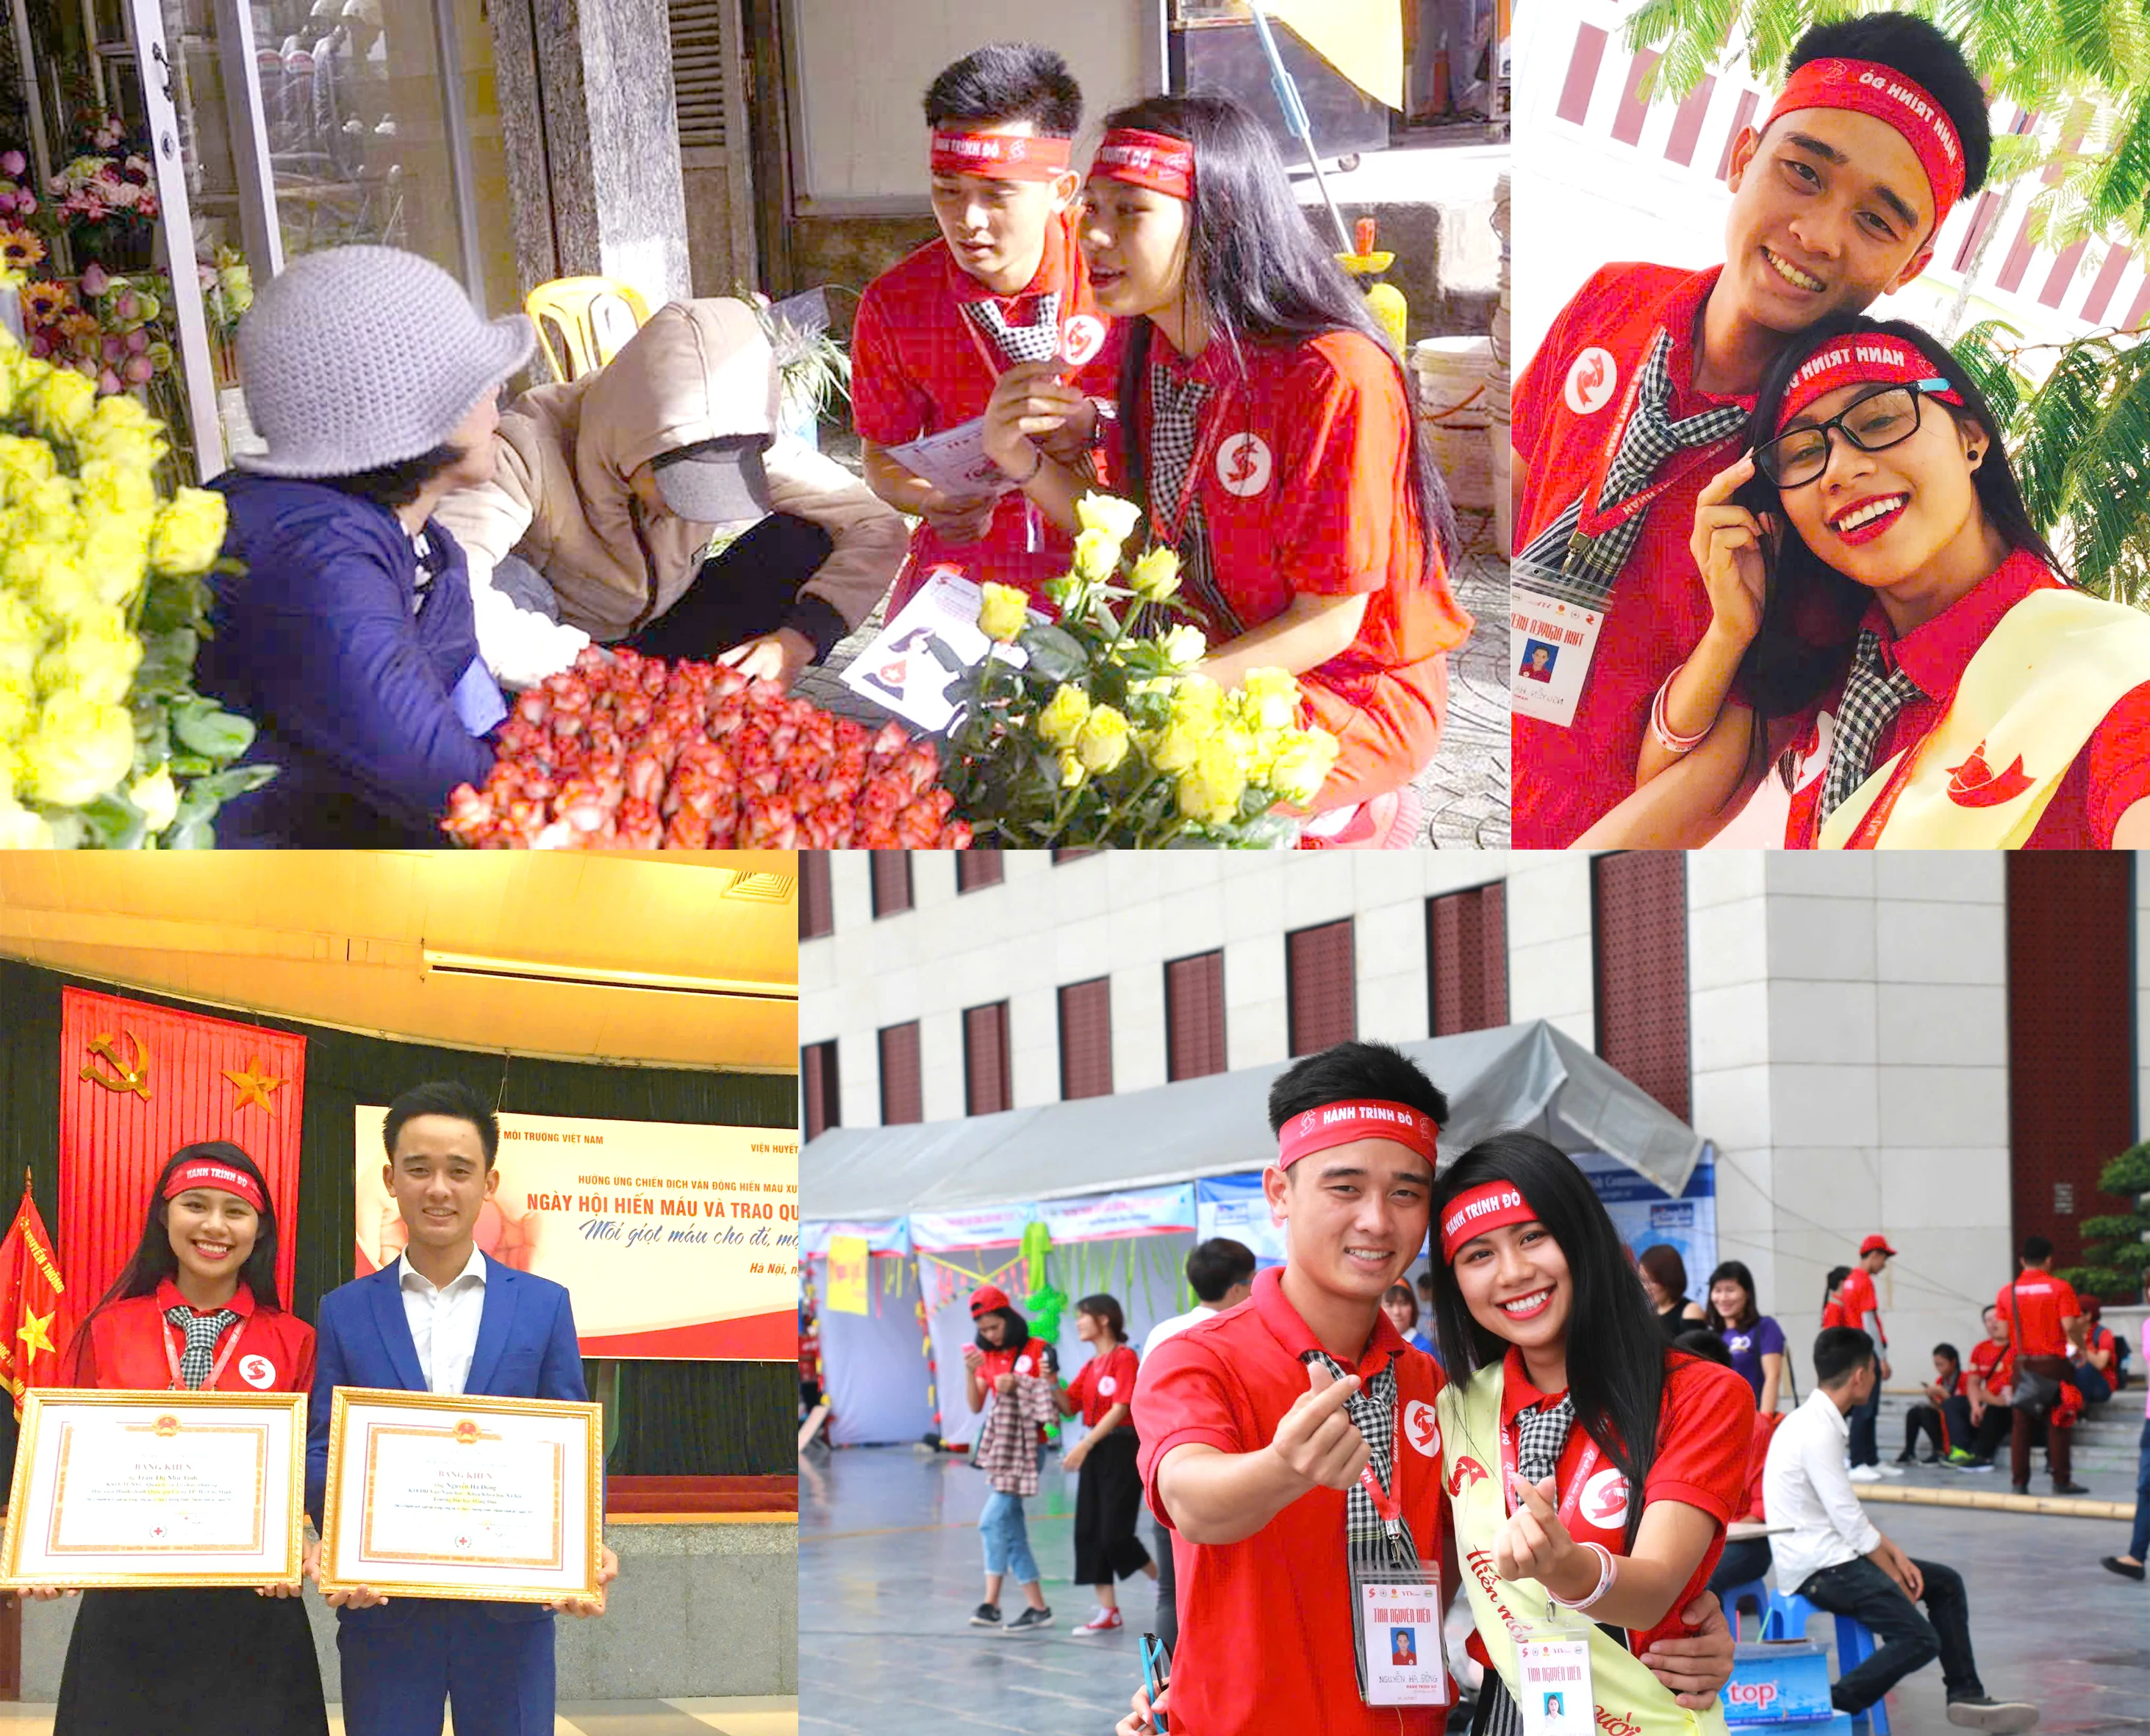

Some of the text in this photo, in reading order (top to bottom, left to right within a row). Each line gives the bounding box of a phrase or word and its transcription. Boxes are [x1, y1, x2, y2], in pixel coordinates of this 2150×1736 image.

[1324, 1104, 1412, 1126] HÀNH TRÌNH ĐỎ
[504, 1130, 521, 1140] MÔI
[562, 1133, 581, 1144] VIỆT
[584, 1135, 603, 1144] NAM
[750, 1142, 770, 1155] VIỆN
[527, 1190, 572, 1211] NGÀY
[578, 1192, 607, 1216] HỘI
[615, 1192, 653, 1215] HIẾN
[661, 1196, 698, 1217] MÁU
[704, 1197, 725, 1217] VÀ
[731, 1202, 773, 1220] TRAO
[1465, 1196, 1500, 1220] TRÌNH
[1502, 1188, 1521, 1208] ĐỎ
[625, 1222, 663, 1248] giọt
[667, 1223, 708, 1244] máu
[714, 1225, 744, 1244] cho
[750, 1263, 764, 1274] Hà
[1729, 1681, 1777, 1709] top
